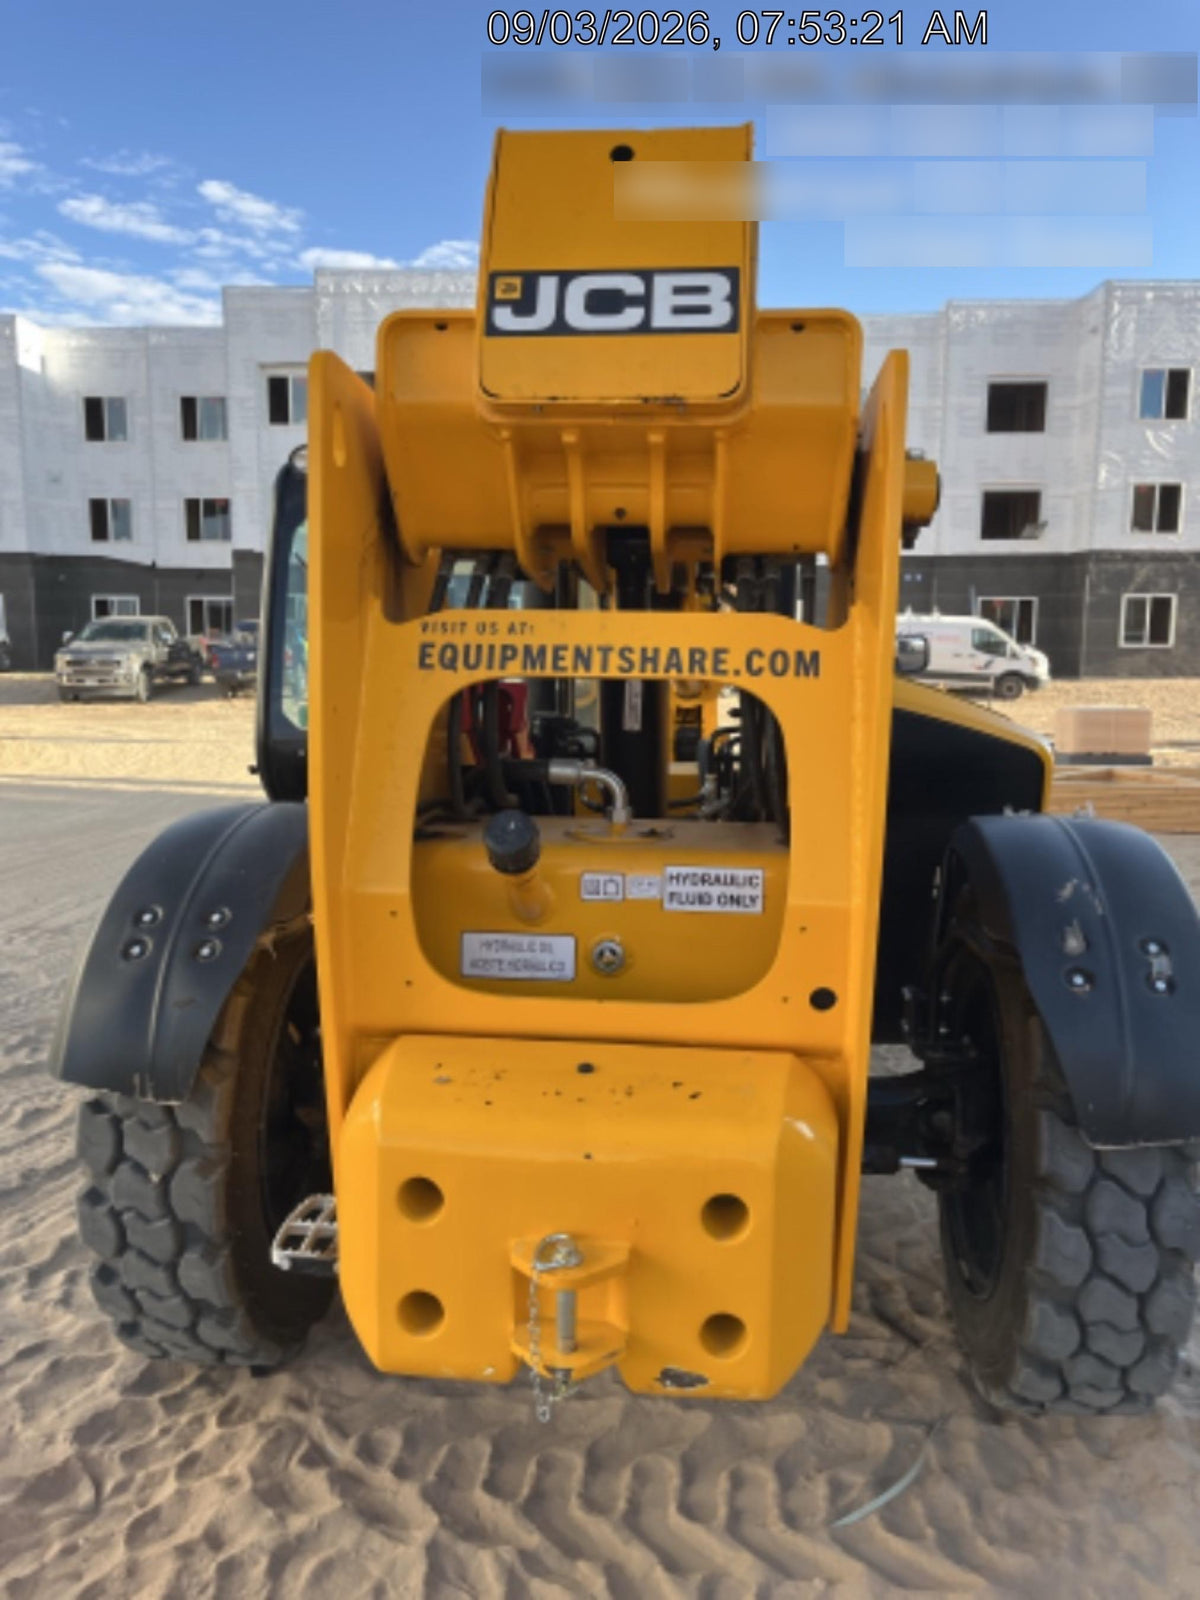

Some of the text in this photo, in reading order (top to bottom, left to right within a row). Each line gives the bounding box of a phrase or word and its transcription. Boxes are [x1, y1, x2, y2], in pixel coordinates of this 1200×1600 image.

[491, 271, 735, 332] JCB
[421, 621, 467, 635] VISIT
[475, 621, 499, 636] US
[418, 641, 822, 678] EQUIPMENTSHARE.COM
[668, 872, 760, 889] HYDRAULIC
[668, 891, 760, 909] FLUID ONLY
